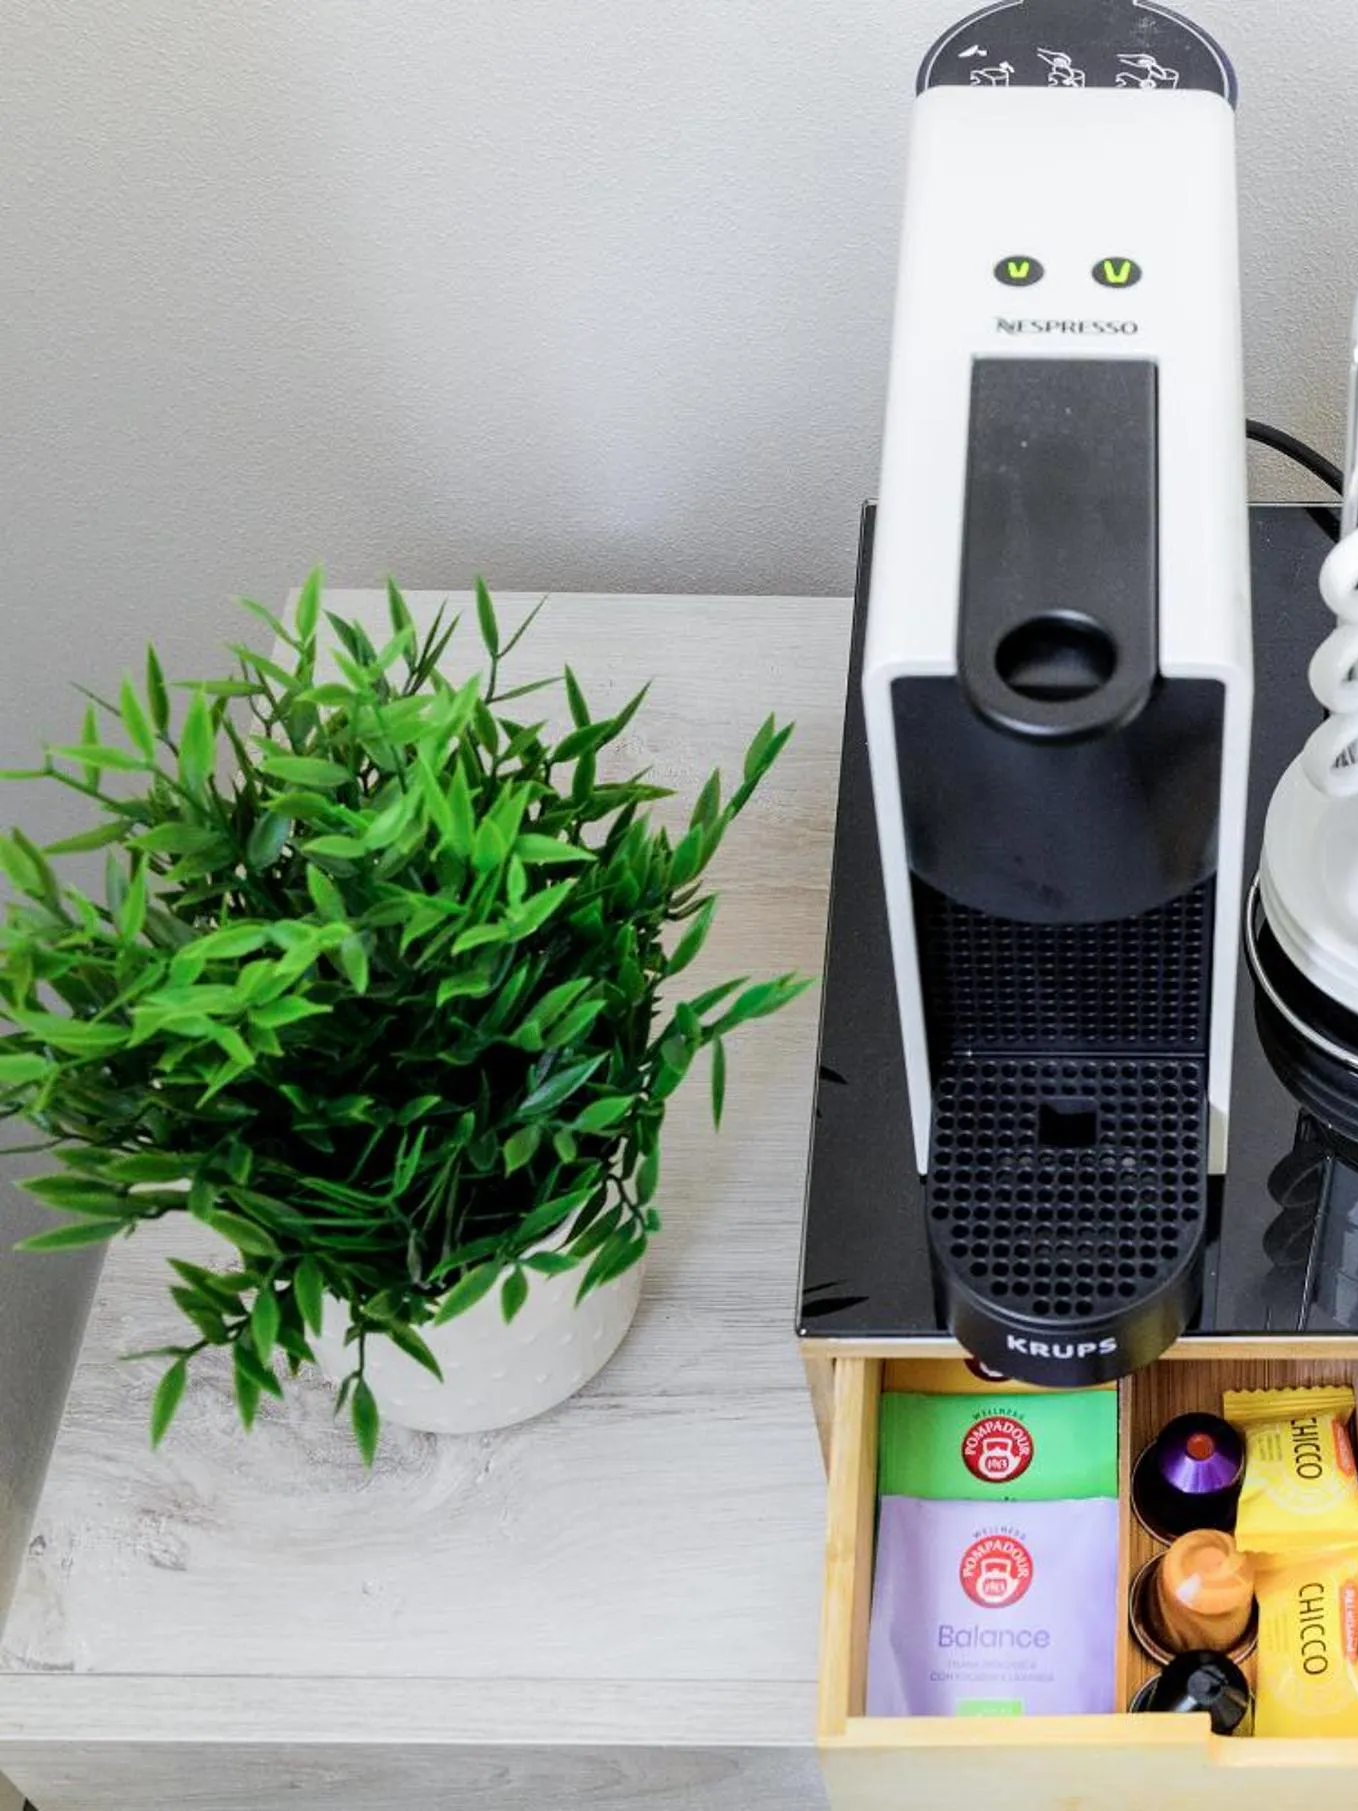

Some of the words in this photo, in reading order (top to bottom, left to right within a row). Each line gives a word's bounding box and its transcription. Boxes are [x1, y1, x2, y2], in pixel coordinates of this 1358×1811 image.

[994, 317, 1138, 335] NESPRESSO
[1006, 1334, 1117, 1359] KRUPS
[964, 1420, 1033, 1456] POMPADOUR
[963, 1539, 1030, 1578] POMPADOUR
[938, 1625, 1051, 1648] Balance
[1298, 1582, 1328, 1675] CHICCO
